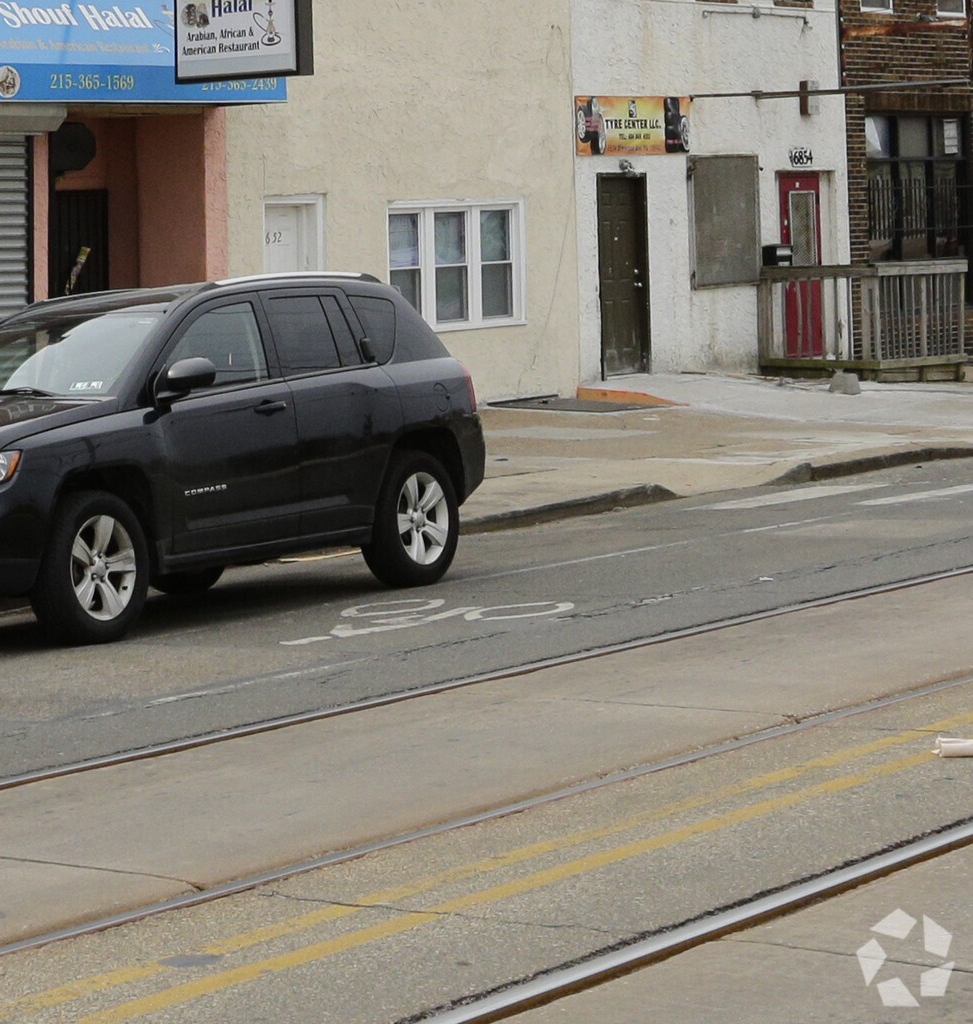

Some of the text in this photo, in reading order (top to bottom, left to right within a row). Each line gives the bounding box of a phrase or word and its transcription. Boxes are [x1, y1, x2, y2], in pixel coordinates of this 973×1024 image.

[79, 4, 153, 31] Halal
[187, 26, 254, 42] Arabian, African &
[182, 41, 260, 56] American Restaurant
[50, 73, 134, 90] 215-365-1569
[605, 119, 622, 129] TYRE
[624, 119, 648, 129] CENTER
[794, 150, 813, 165] 6854
[184, 484, 227, 496] COMPASS
